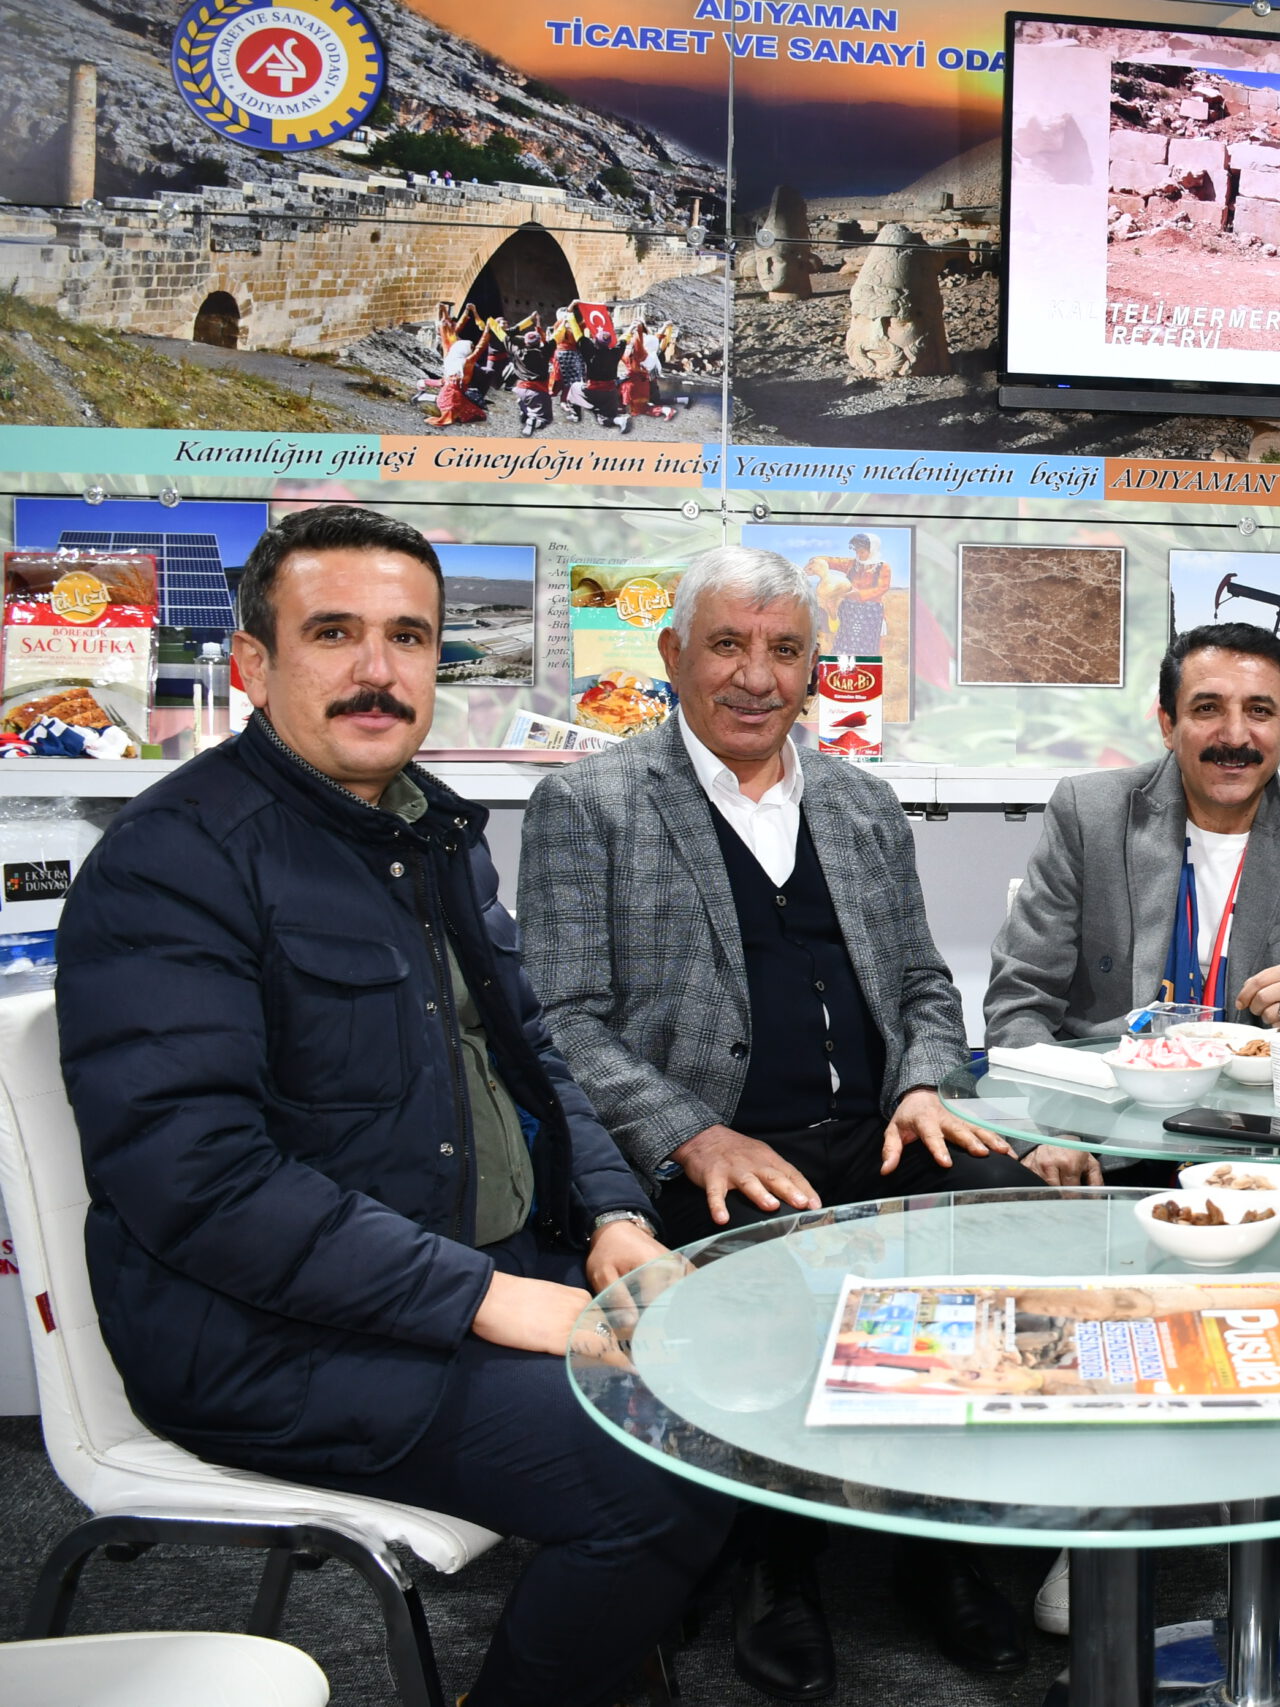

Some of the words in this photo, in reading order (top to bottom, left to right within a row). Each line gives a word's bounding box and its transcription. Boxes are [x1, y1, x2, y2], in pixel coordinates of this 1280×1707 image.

[696, 0, 899, 32] ADIYAMAN
[217, 22, 246, 82] TİCARET
[247, 12, 268, 27] VE
[271, 11, 331, 41] SANAYİ
[325, 42, 341, 88] ODASI
[545, 17, 713, 55] TİCARET
[724, 33, 778, 59] VE
[788, 39, 926, 69] SANAYİ
[235, 90, 322, 116] ADIYAMAN
[173, 439, 324, 474] Karanlığın
[326, 445, 417, 474] güneşi
[653, 452, 722, 476] incisi
[734, 454, 857, 486] Yaşanmış
[862, 457, 1015, 493] medeniyetin
[1027, 464, 1100, 498] beşiği
[1110, 467, 1278, 495] ADIYAMAN
[21, 637, 62, 654] SAC
[66, 638, 136, 654] YUFKA
